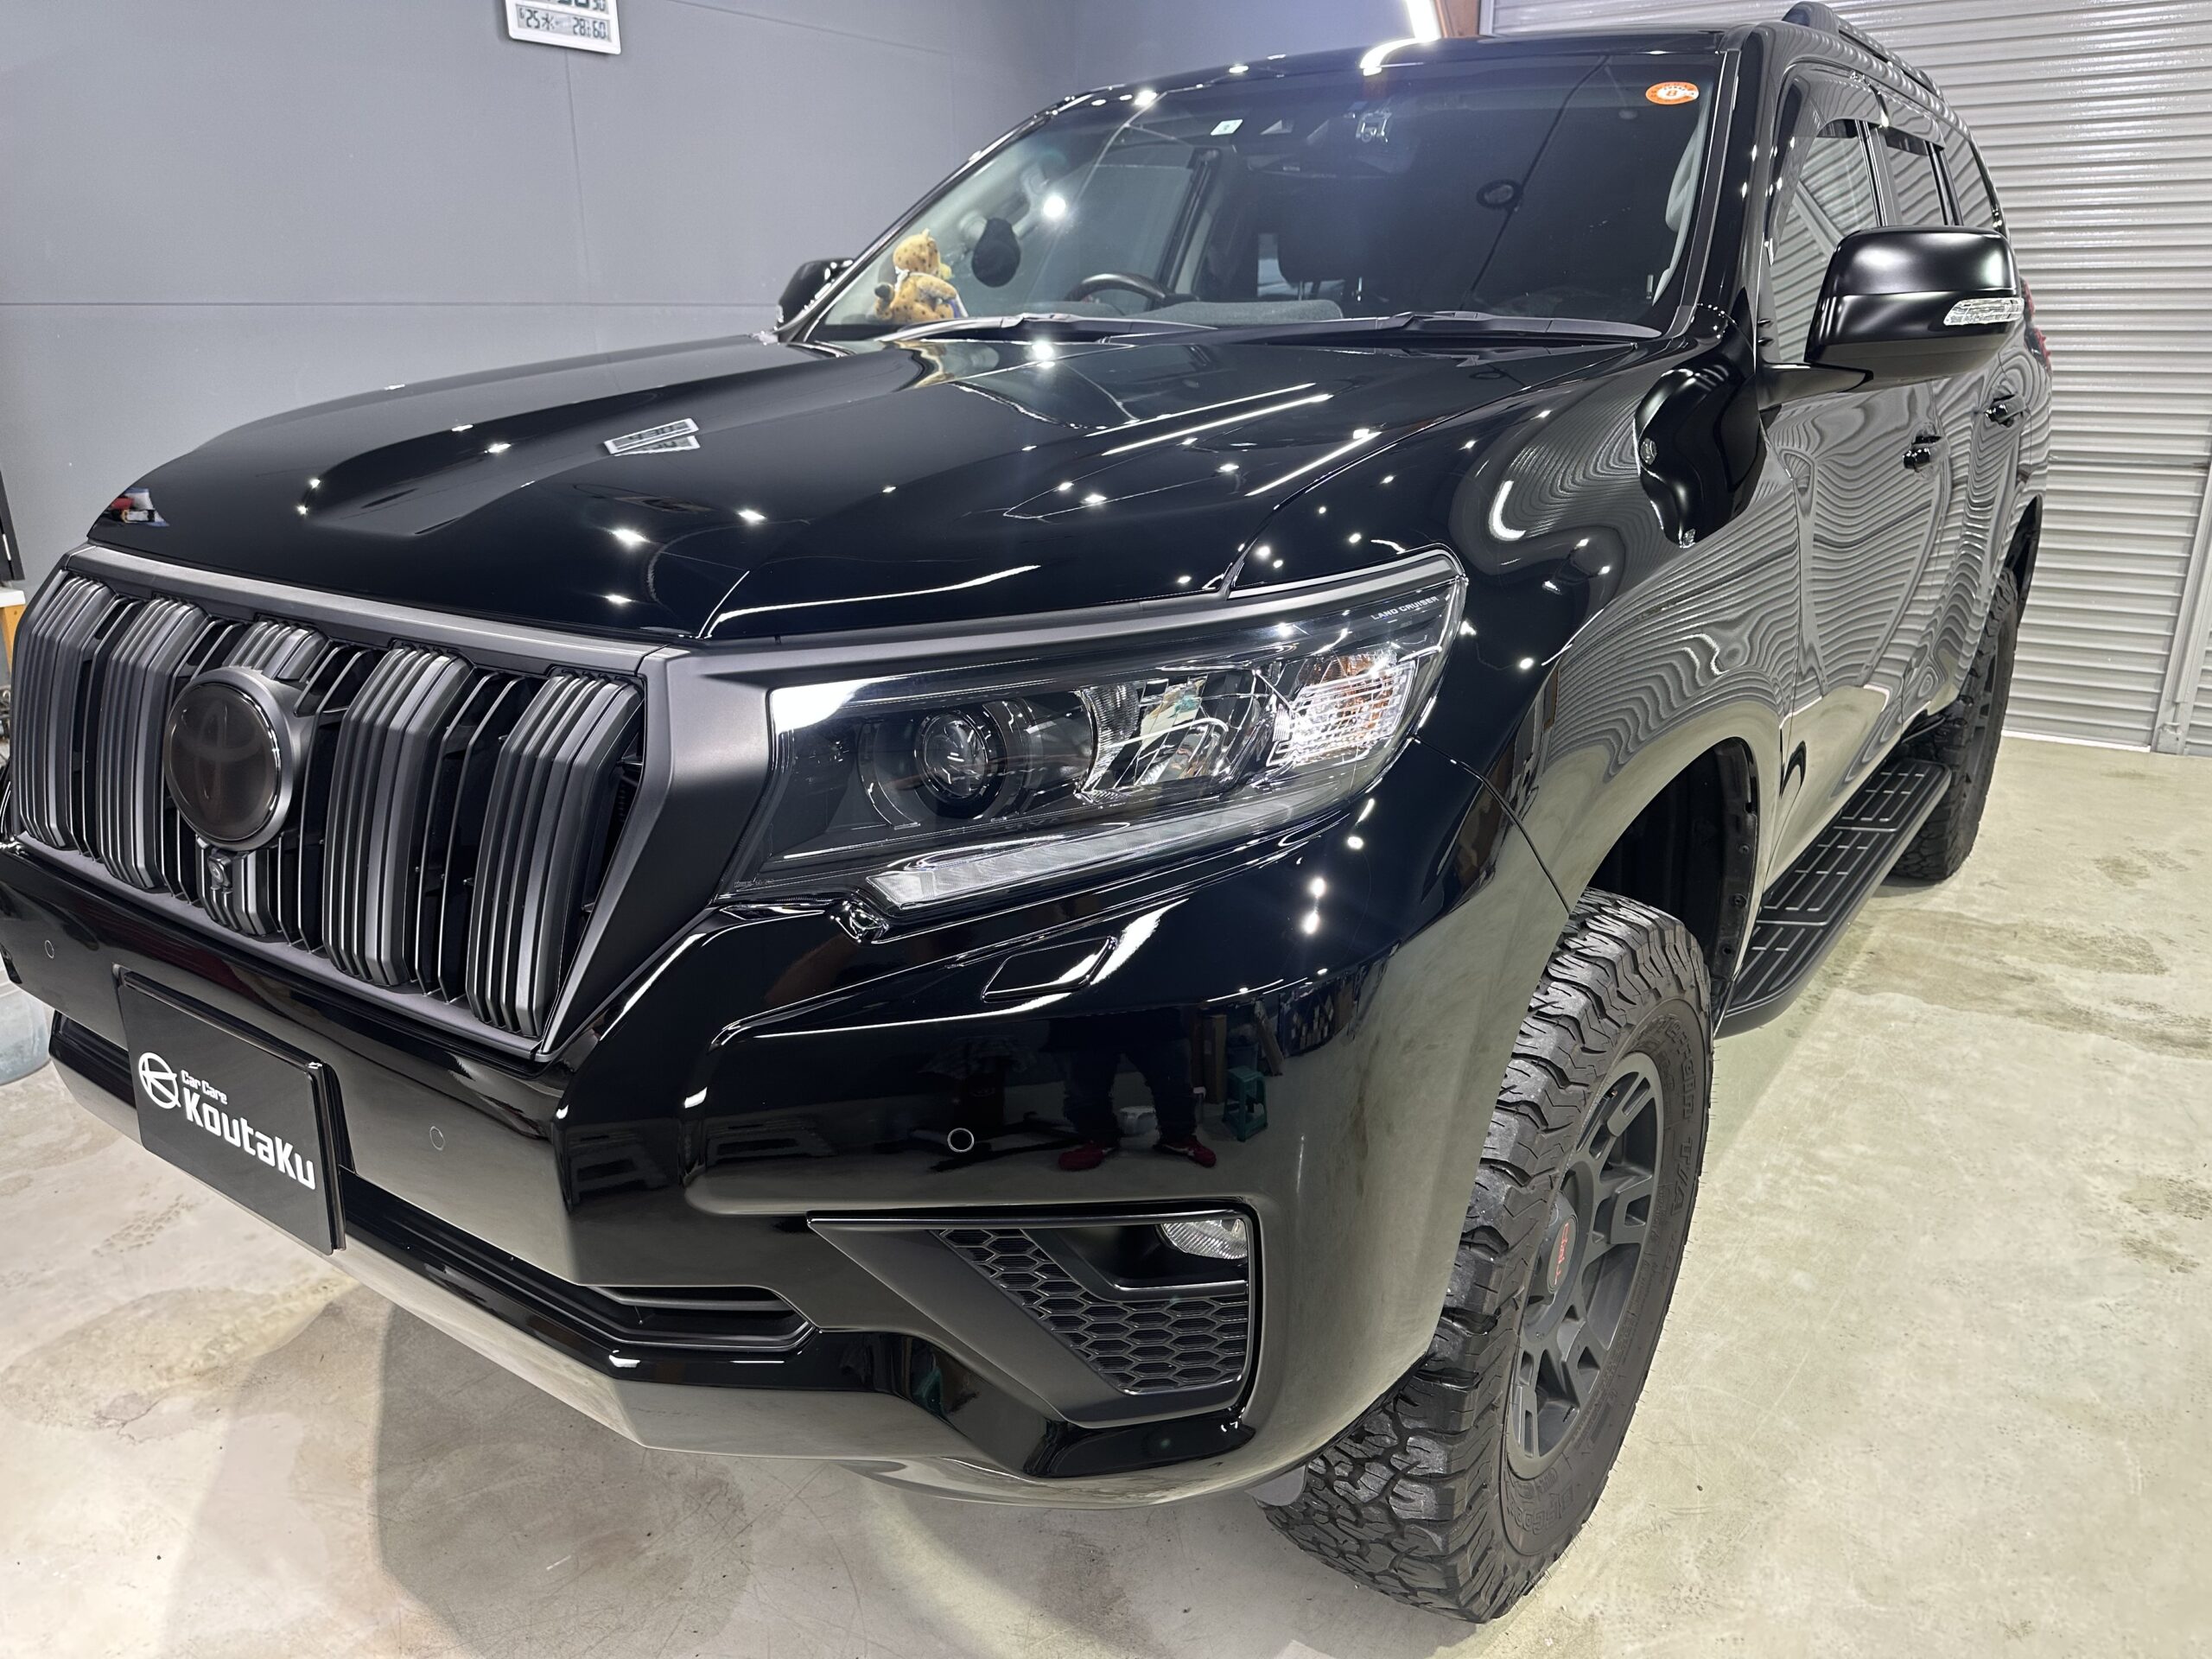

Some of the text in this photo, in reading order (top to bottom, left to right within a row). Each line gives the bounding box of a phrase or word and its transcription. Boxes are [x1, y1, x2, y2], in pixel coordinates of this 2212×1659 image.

[1370, 596, 1440, 620] LAND CRUISER
[181, 1070, 228, 1105] Car Care
